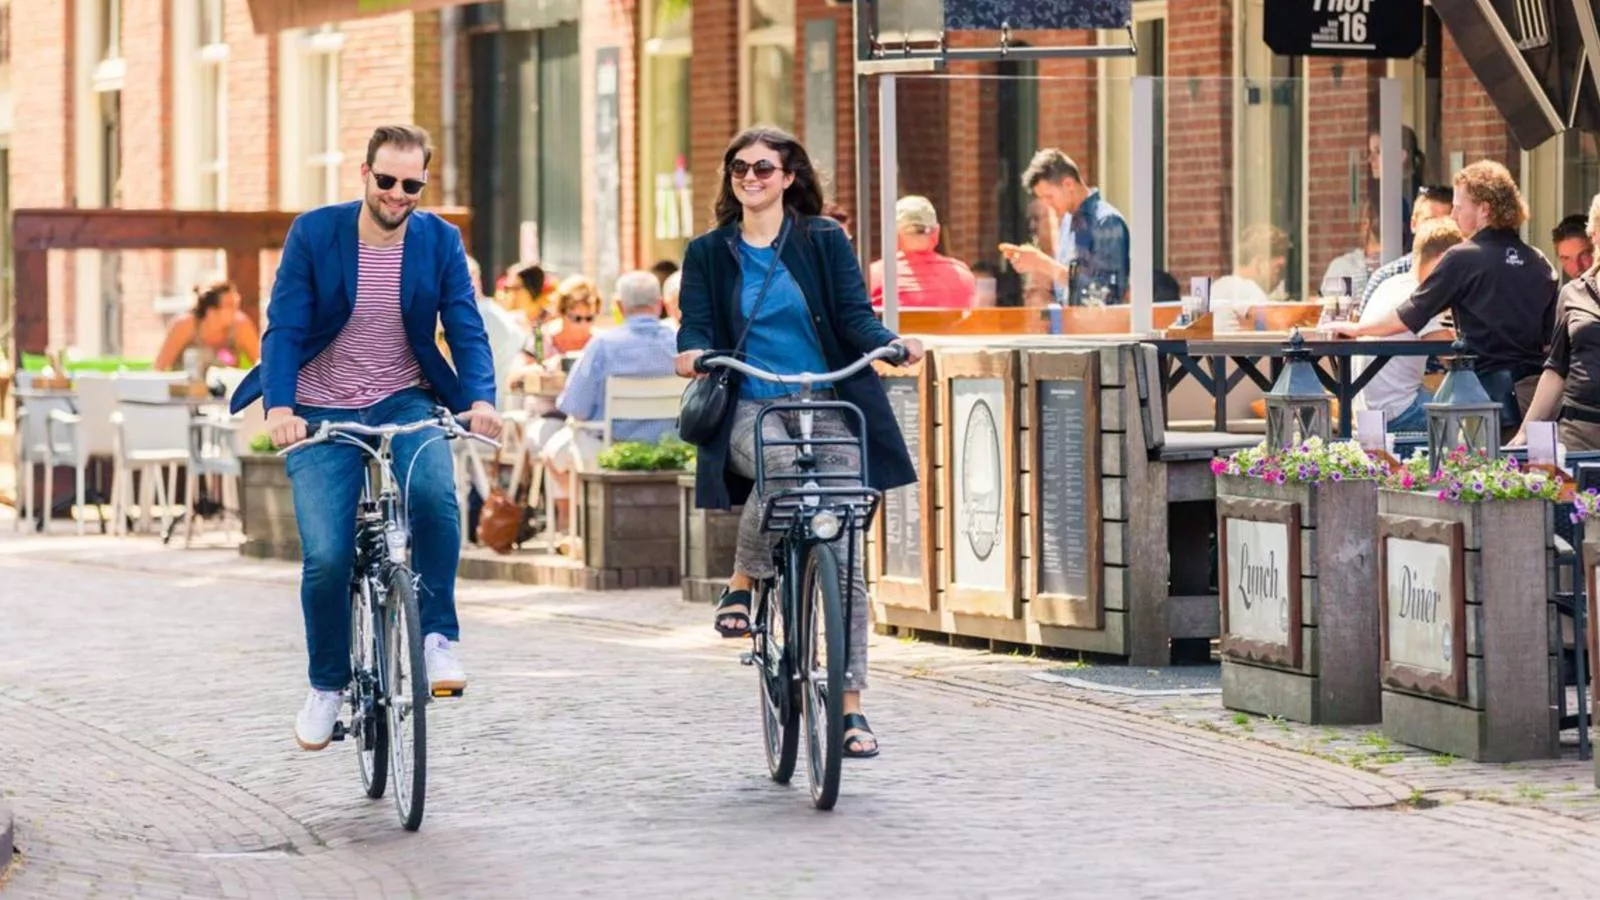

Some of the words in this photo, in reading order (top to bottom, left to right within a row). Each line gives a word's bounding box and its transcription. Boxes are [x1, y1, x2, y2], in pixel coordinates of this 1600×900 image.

[1338, 12, 1368, 43] 16
[1238, 542, 1278, 611] Lunch
[1399, 564, 1441, 623] Diner
